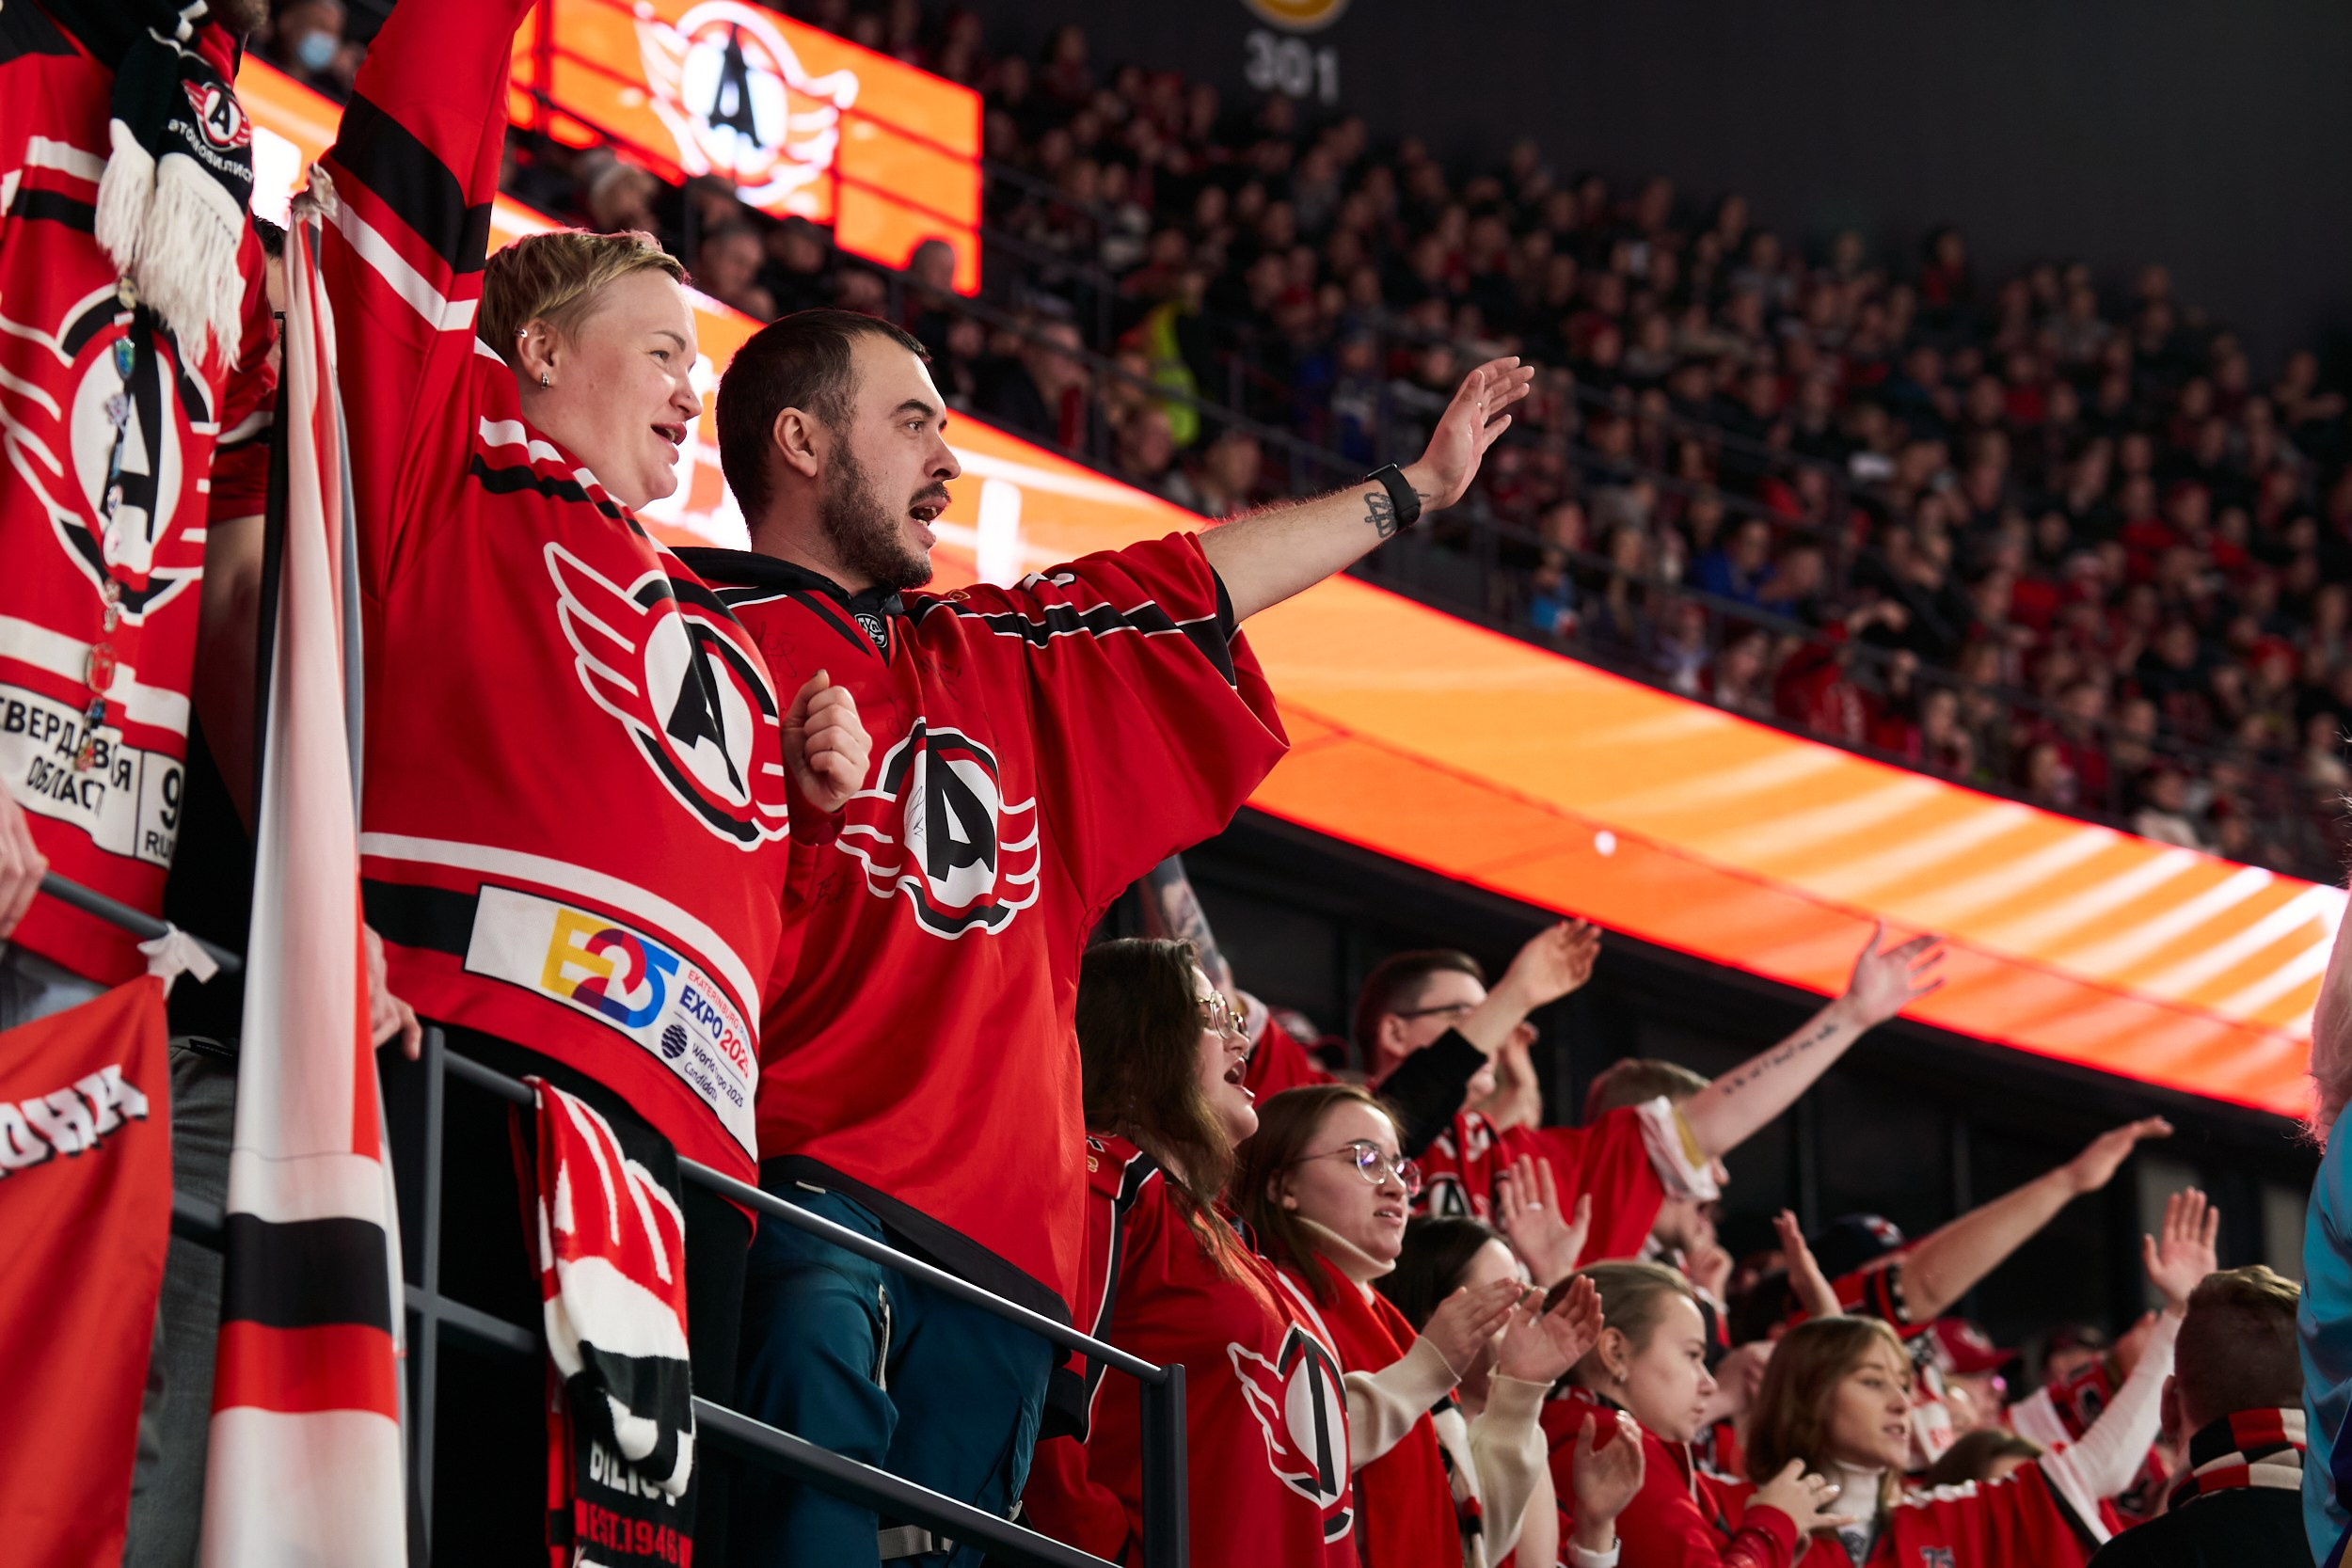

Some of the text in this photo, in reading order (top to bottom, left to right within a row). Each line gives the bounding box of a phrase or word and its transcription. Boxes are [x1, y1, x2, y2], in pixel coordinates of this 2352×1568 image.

[1243, 29, 1339, 105] 301
[679, 984, 723, 1039] EXPO
[688, 970, 739, 1029] EKATERINBURG
[692, 1042, 715, 1072] World
[726, 1085, 743, 1108] 2025
[589, 1502, 678, 1564] EST.1946
